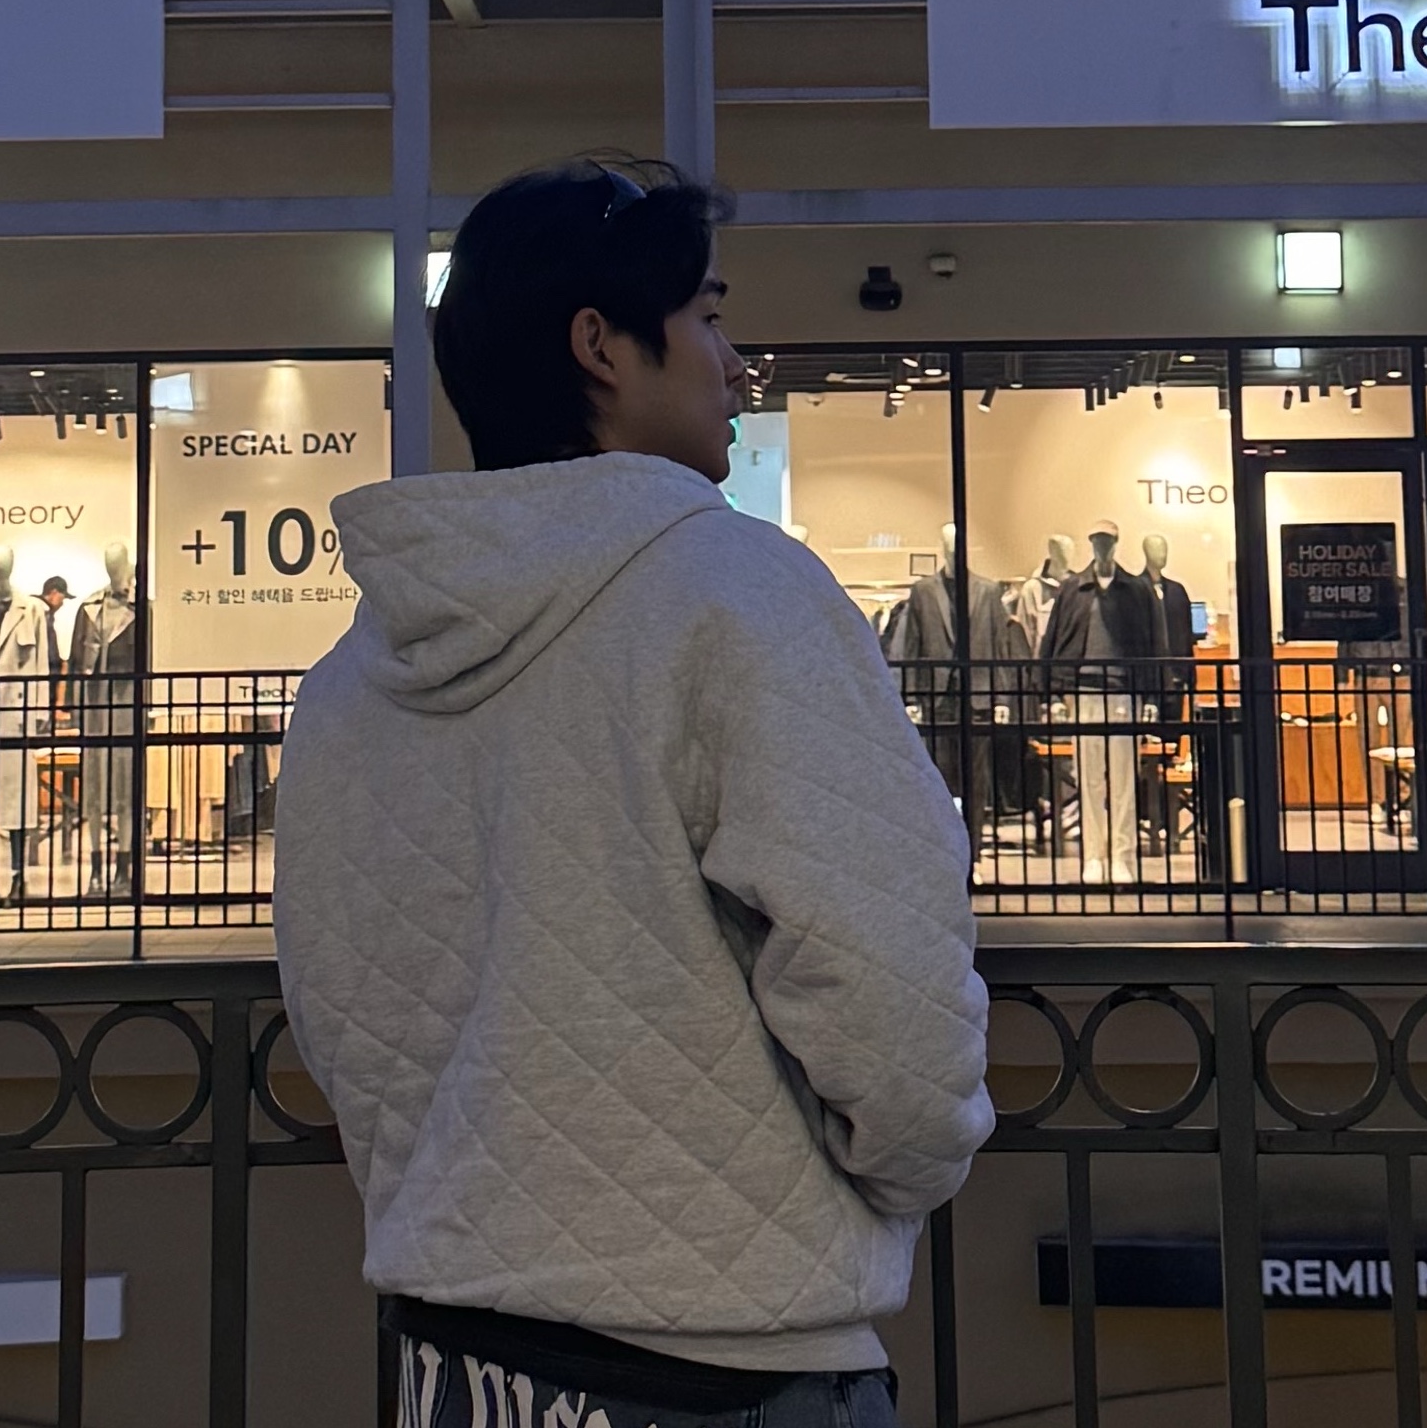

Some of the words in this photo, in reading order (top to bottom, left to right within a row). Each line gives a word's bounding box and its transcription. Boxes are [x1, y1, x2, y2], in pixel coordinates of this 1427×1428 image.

[182, 434, 292, 456] SPECIAL
[302, 432, 357, 455] DAY
[1299, 545, 1376, 560] HOLIDAY
[1288, 562, 1342, 578] SUPER
[1346, 561, 1392, 577] SALE
[181, 589, 211, 605] 추가
[218, 588, 245, 605] 할인
[300, 586, 359, 603] 드립니다
[1308, 585, 1372, 603] 참여매장
[238, 685, 298, 703] Teoy
